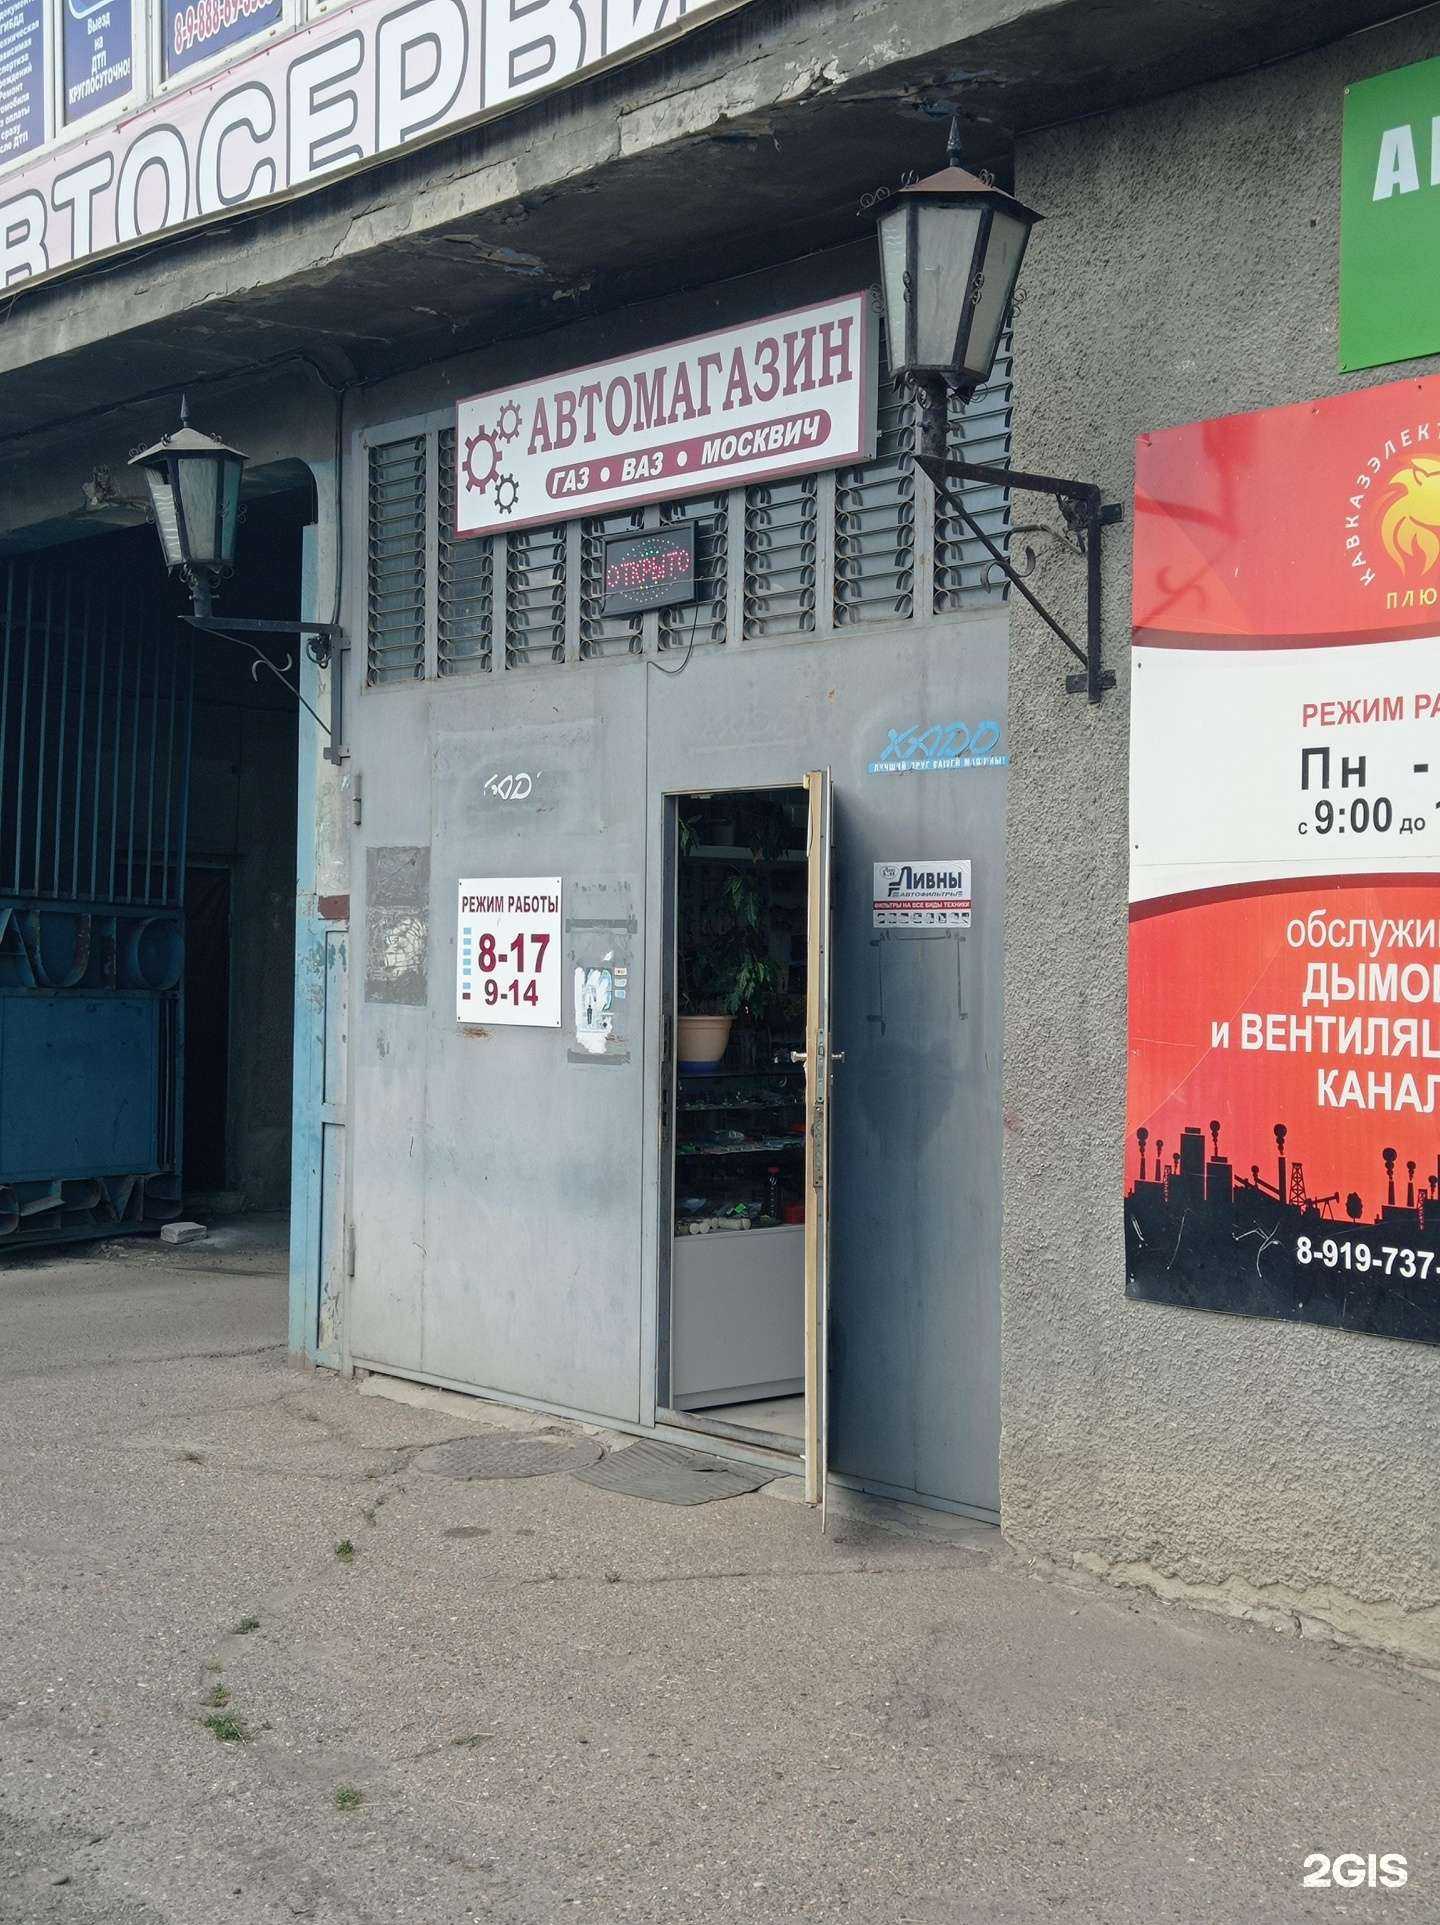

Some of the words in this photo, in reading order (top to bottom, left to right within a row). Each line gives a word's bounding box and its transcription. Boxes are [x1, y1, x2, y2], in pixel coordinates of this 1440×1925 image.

[87, 12, 110, 35] Выезд
[91, 50, 107, 76] ДТП
[94, 36, 103, 51] на
[68, 57, 131, 105] КРУГЛОСУТОЧНО!
[13, 130, 29, 150] ДТП
[1373, 115, 1440, 202] А
[527, 316, 854, 456] АВТОМАГАЗИН
[551, 467, 590, 494] ГАЗ
[621, 451, 664, 482] ВАЗ
[701, 415, 820, 466] МОСКВИЧ
[1344, 422, 1440, 586] КАВКАЗЭЛЕК
[607, 549, 690, 588] ОТКРЫТО
[1302, 696, 1404, 728] РЕЖИМ
[1301, 747, 1367, 790] Пн
[1298, 822, 1308, 835] с
[1314, 797, 1393, 835] 9:00
[1400, 817, 1426, 835] до
[462, 895, 504, 913] РЕЖИМ
[508, 895, 559, 913] РАБОТЫ
[1286, 908, 1440, 958] обслужи
[478, 932, 550, 974] 8-17
[484, 978, 539, 1007] 9-14
[1302, 962, 1440, 1008] ДЫМО
[1211, 1020, 1230, 1049] и
